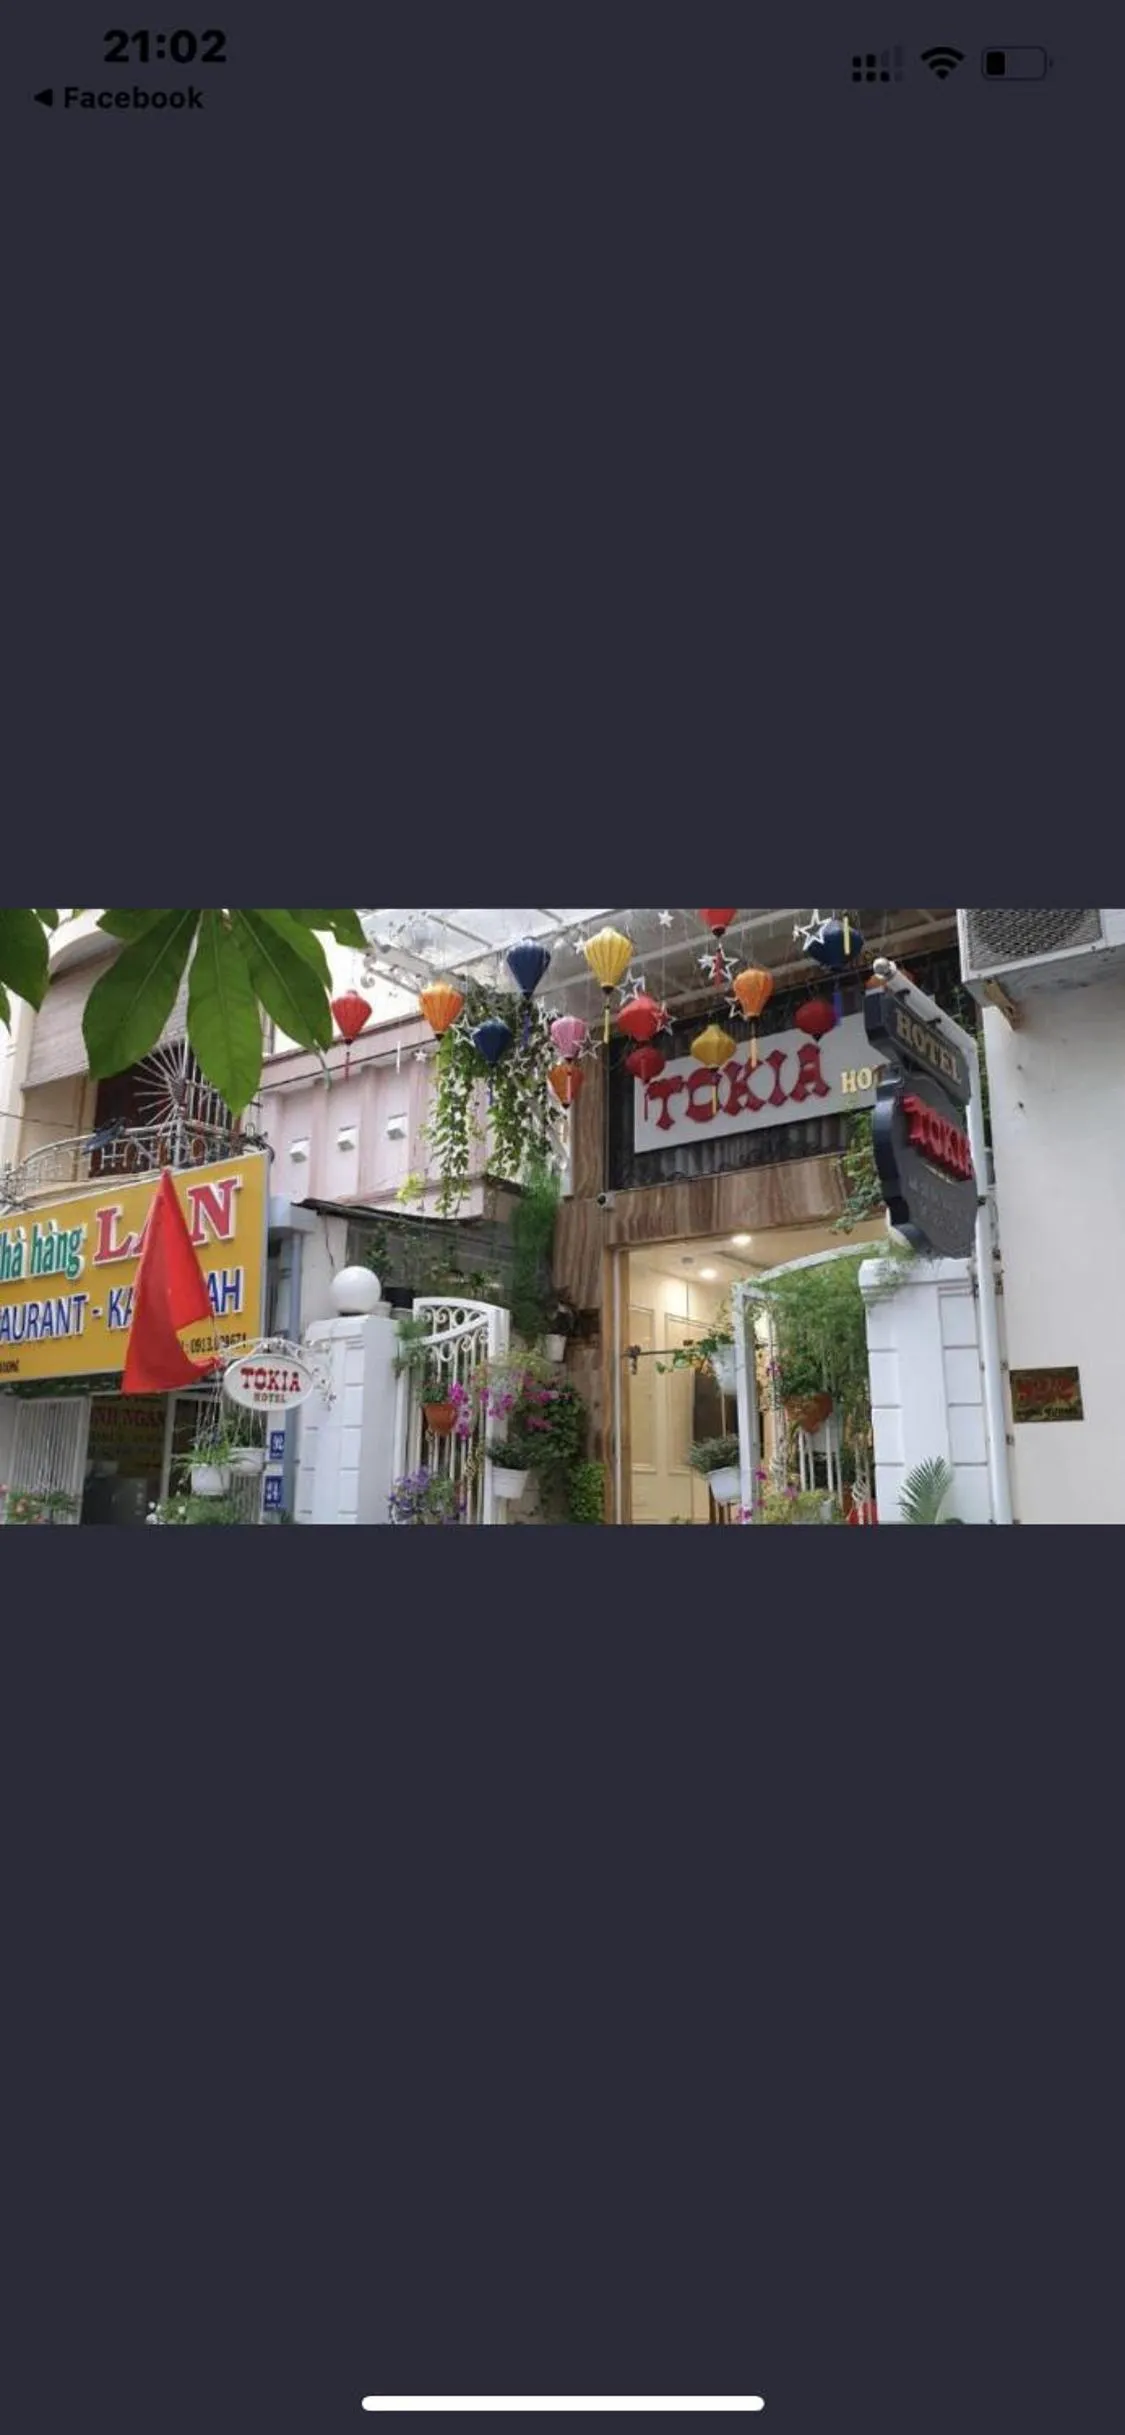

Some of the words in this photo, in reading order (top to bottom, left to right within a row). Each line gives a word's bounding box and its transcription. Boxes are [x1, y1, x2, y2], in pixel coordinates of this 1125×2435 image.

[895, 1007, 962, 1087] HOTEL
[646, 1042, 831, 1131] TOKIA
[0, 1227, 25, 1280] hà
[30, 1220, 84, 1278] hàng
[241, 1366, 301, 1392] TOKIA
[253, 1392, 287, 1404] HOTEL
